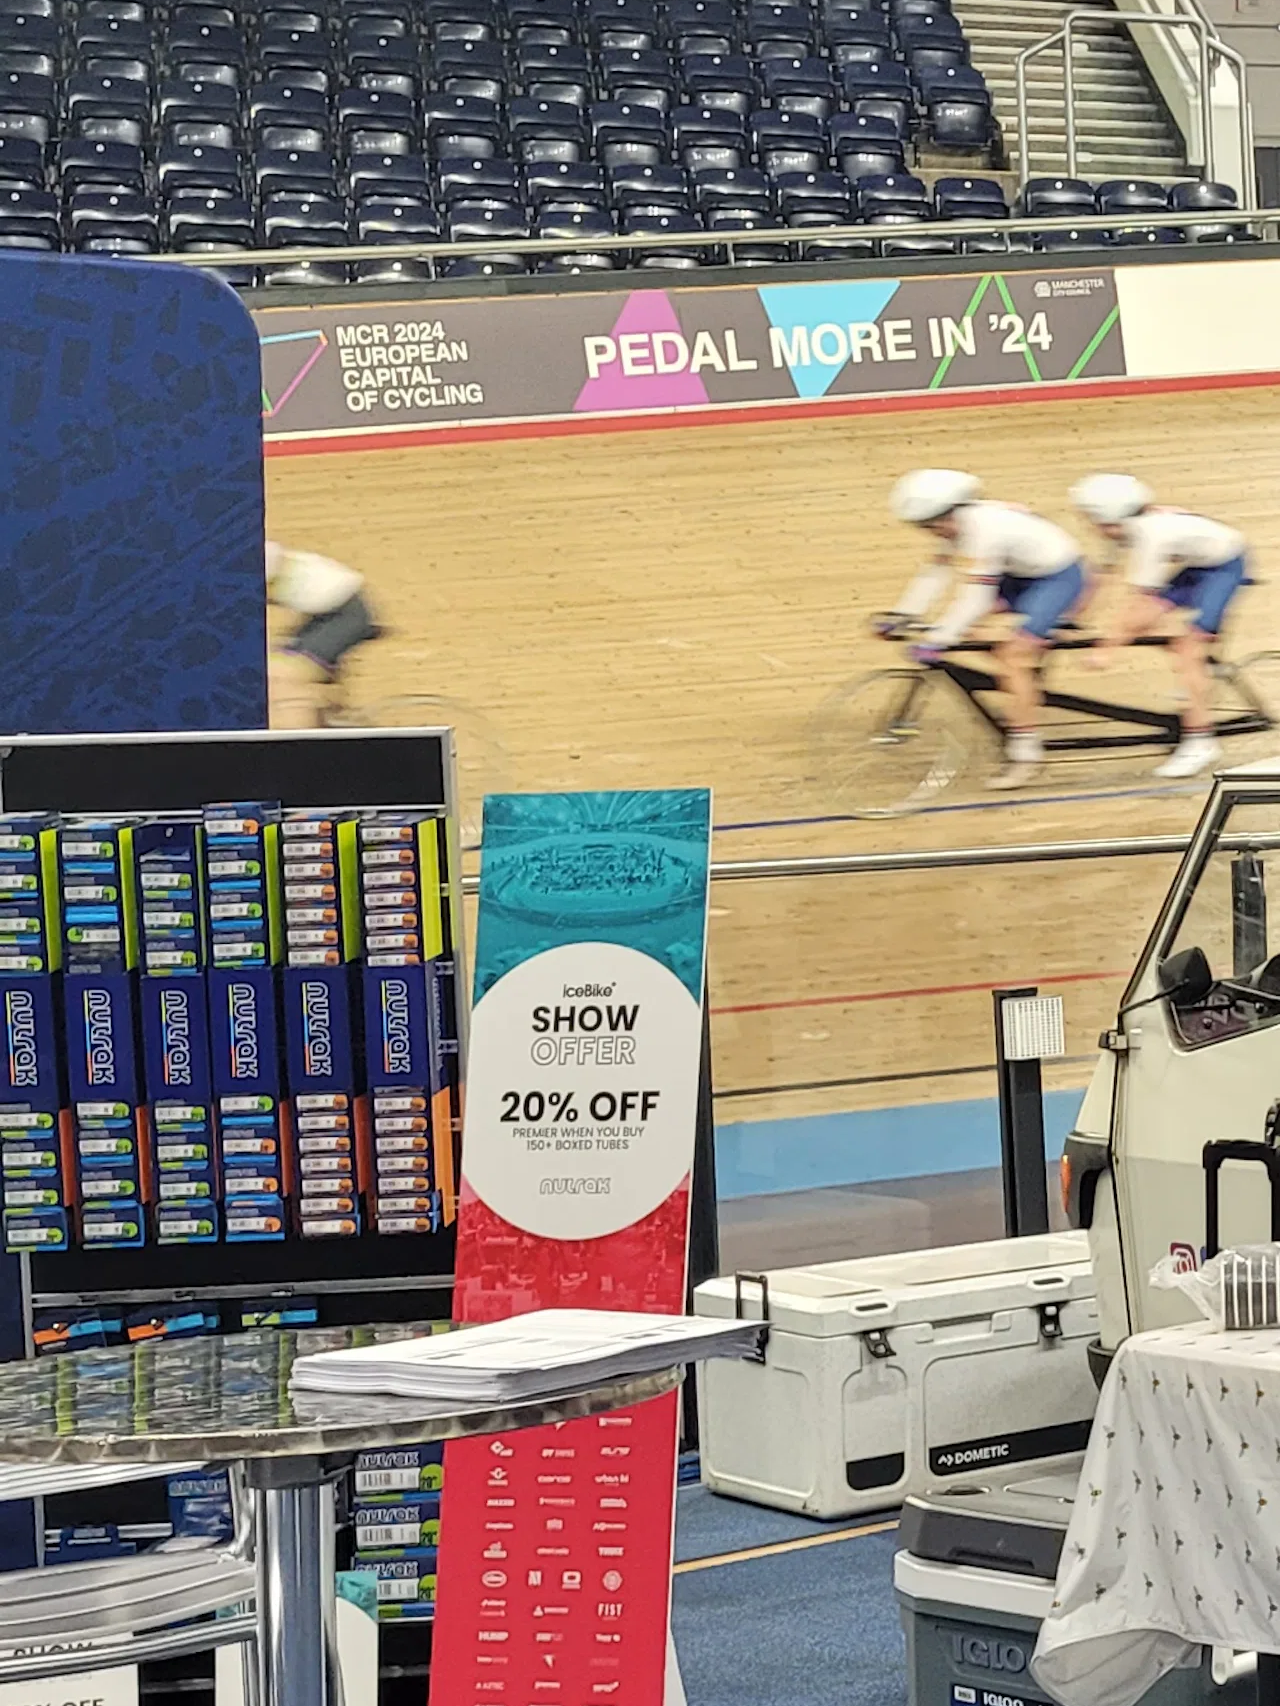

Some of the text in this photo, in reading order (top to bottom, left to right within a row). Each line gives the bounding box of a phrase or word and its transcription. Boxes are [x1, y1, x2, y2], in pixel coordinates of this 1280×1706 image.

[335, 321, 446, 346] MCR 2024
[583, 312, 1053, 379] PEDAL MORE IN '24
[339, 341, 469, 368] EUROPEAN
[343, 365, 442, 390] CAPITAL
[346, 383, 484, 412] OF CYCLING
[531, 1004, 640, 1033] SHOW
[530, 1035, 636, 1066] OFFER
[499, 1091, 661, 1123] 20% OFF
[512, 1126, 645, 1138] PREMIER WHEN YOU BUY
[555, 1140, 592, 1150] BOXED
[596, 1139, 629, 1150] TUBES
[954, 1443, 1009, 1464] DOMETIC
[598, 1603, 623, 1617] FIST
[953, 1634, 1027, 1674] IGLO
